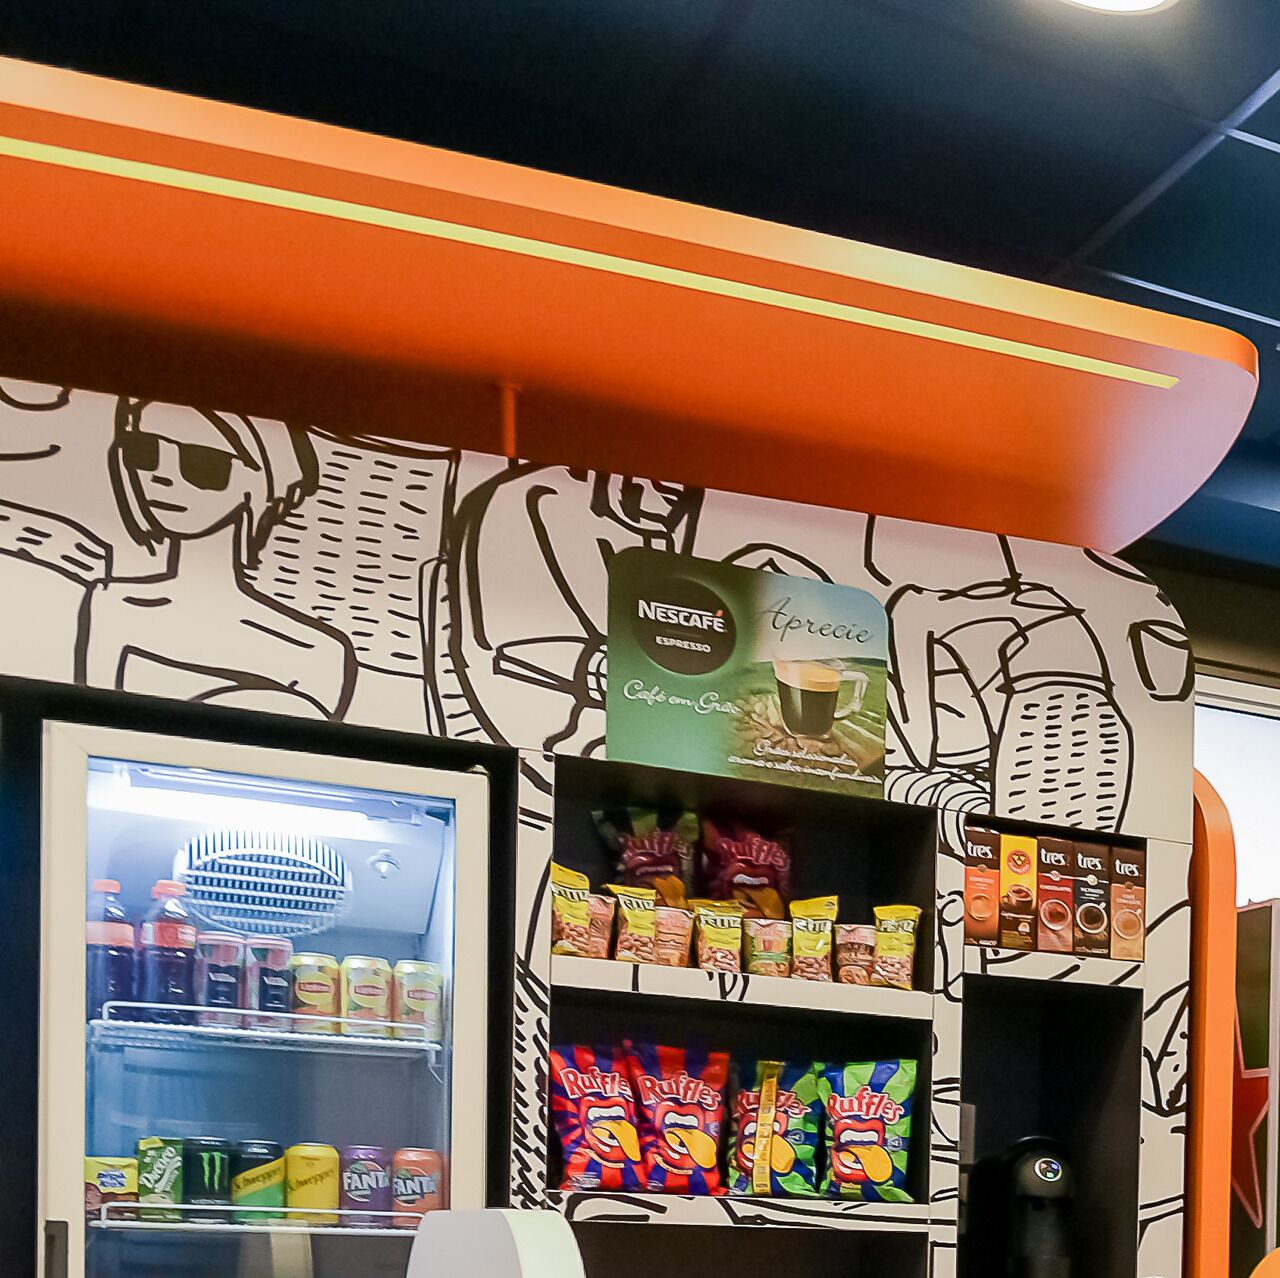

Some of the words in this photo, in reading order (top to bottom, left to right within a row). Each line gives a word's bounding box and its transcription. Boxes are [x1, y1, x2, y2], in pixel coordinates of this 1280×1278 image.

[638, 600, 727, 632] NESCAFÉ
[756, 597, 874, 643] Aprecie
[656, 636, 711, 653] ESPRESSO
[623, 679, 665, 706] Café
[967, 841, 993, 858] tres
[1040, 848, 1067, 866] tres
[1077, 852, 1103, 871] tres
[1115, 859, 1140, 876] tres
[637, 1070, 721, 1111] Ruffles
[827, 1083, 905, 1125] Ruffles
